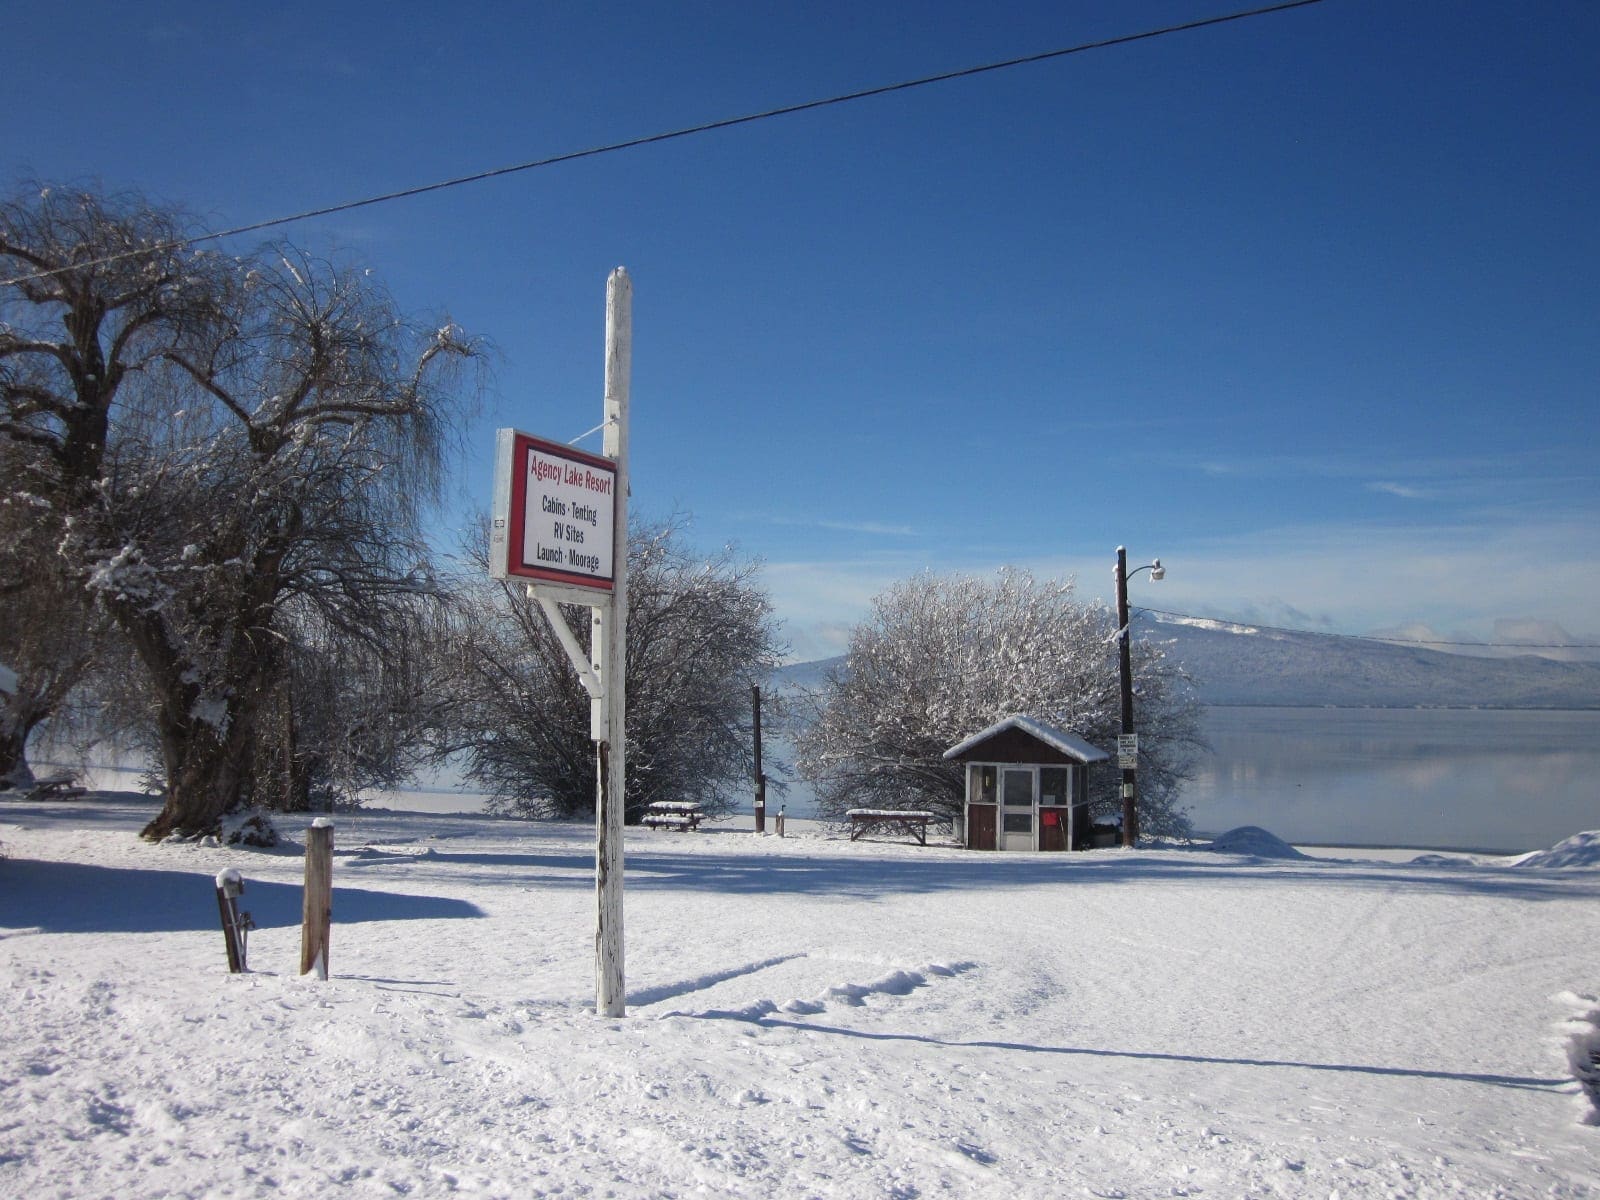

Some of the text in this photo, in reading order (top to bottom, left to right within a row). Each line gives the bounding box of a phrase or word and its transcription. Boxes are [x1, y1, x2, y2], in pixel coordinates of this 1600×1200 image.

[531, 455, 611, 495] Agency Lake Resort
[542, 494, 597, 526] Cabins Tenting
[554, 522, 584, 544] RV Sites
[537, 542, 599, 572] Launch Moorage
